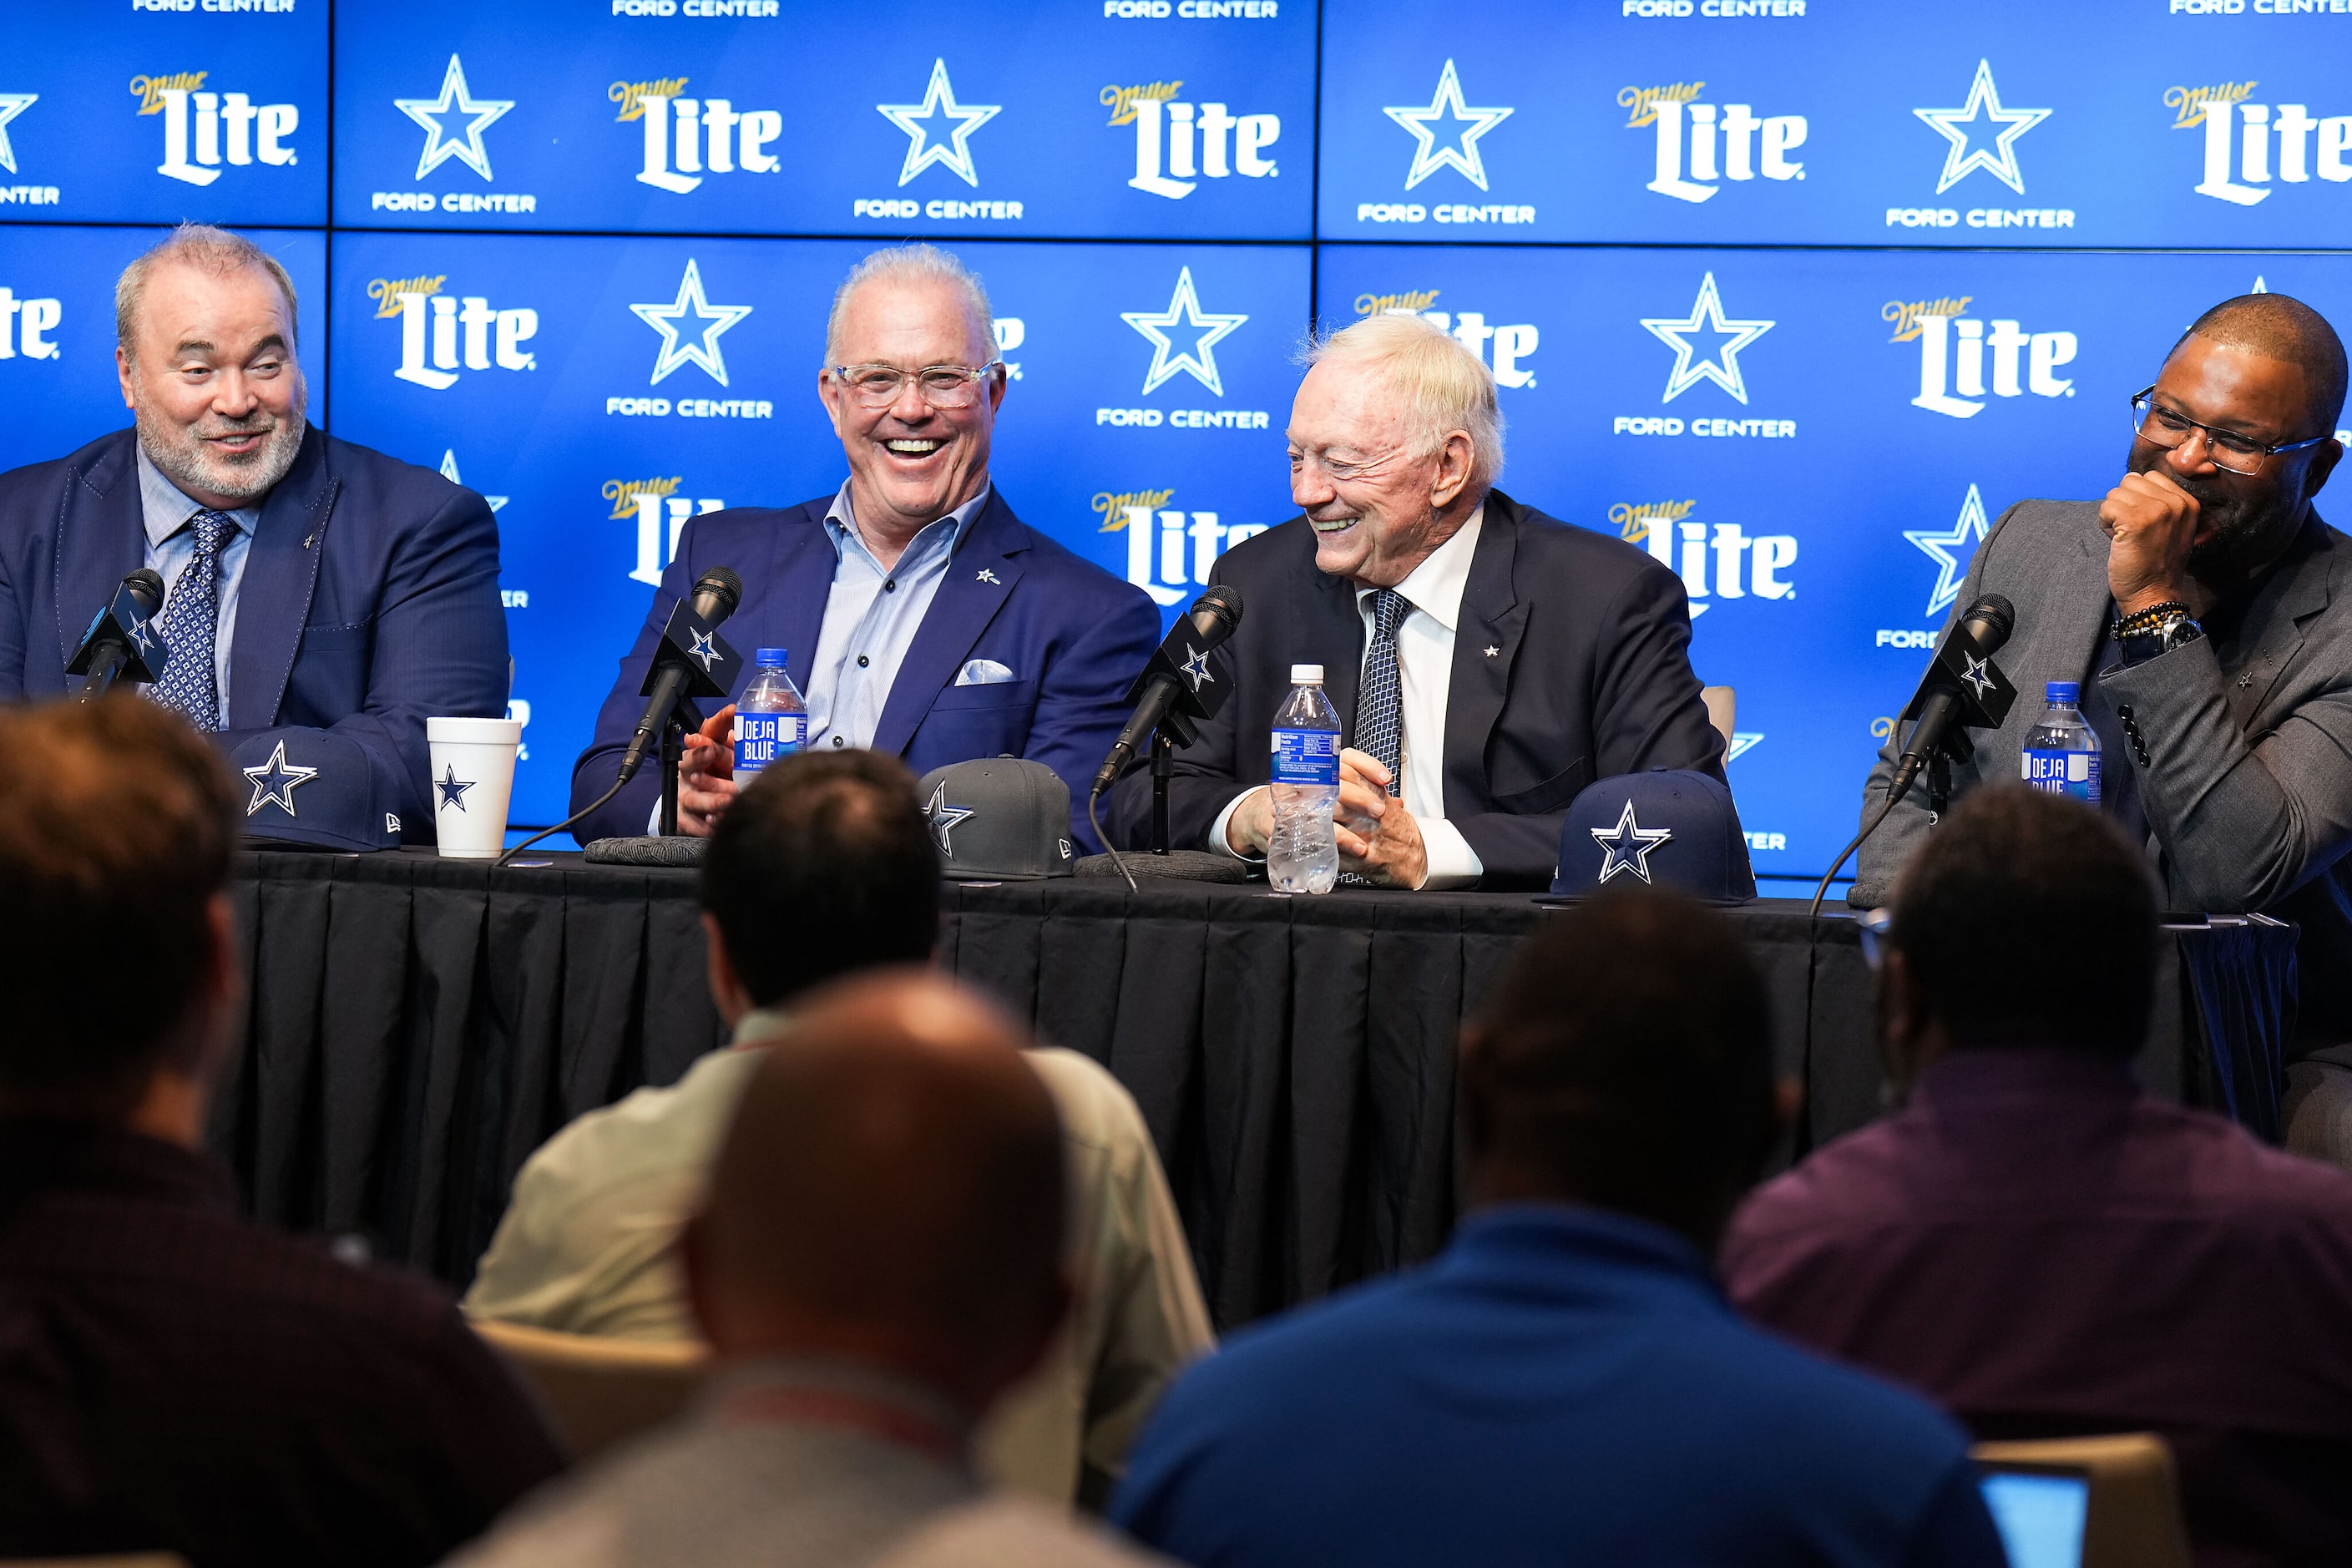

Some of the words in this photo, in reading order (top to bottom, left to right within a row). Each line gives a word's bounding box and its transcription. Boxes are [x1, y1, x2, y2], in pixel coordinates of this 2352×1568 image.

[133, 0, 195, 13] FORD
[201, 0, 294, 13] CENTER
[612, 0, 676, 17] FORD
[682, 0, 778, 17] CENTER
[1104, 1, 1171, 18] FORD
[1177, 1, 1277, 18] CENTER
[1622, 0, 1694, 18] FORD
[1700, 0, 1806, 18] CENTER
[2169, 0, 2245, 14] FORD
[2253, 0, 2352, 14] CENTE
[128, 71, 207, 115] Miller
[606, 77, 688, 122] Miller
[1096, 81, 1182, 126] Miller
[1616, 82, 1704, 128] Miller
[2162, 81, 2256, 129] Miller
[157, 89, 298, 186] Lite
[636, 94, 781, 195] Lite
[1125, 98, 1280, 200] Lite
[1644, 97, 1808, 204] Lite
[372, 193, 436, 213] FORD
[441, 193, 536, 213] CENTER
[853, 200, 920, 219] FORD
[925, 200, 1024, 219] CENTER
[1357, 204, 1427, 224] FORD
[1432, 204, 1535, 224] CENTER
[1885, 208, 1960, 228] FORD
[1965, 208, 2076, 228] CENTER
[365, 275, 446, 318] Miller
[1353, 290, 1439, 315] Miller
[1882, 296, 1971, 342] Miller
[394, 289, 538, 390] Lite
[1909, 312, 2077, 418] Lite
[606, 397, 670, 418] FORD
[677, 397, 772, 418] CENTER
[1096, 408, 1163, 428] FORD
[1169, 408, 1269, 428] CENTER
[1613, 417, 1685, 438] FORD
[1691, 417, 1796, 438] CENTER
[602, 477, 680, 519] Miller
[1090, 489, 1173, 532] Miller
[1607, 499, 1695, 544] Miller
[745, 721, 776, 741] DEJA
[744, 741, 776, 761] BLUE
[2032, 757, 2065, 779] DEJA
